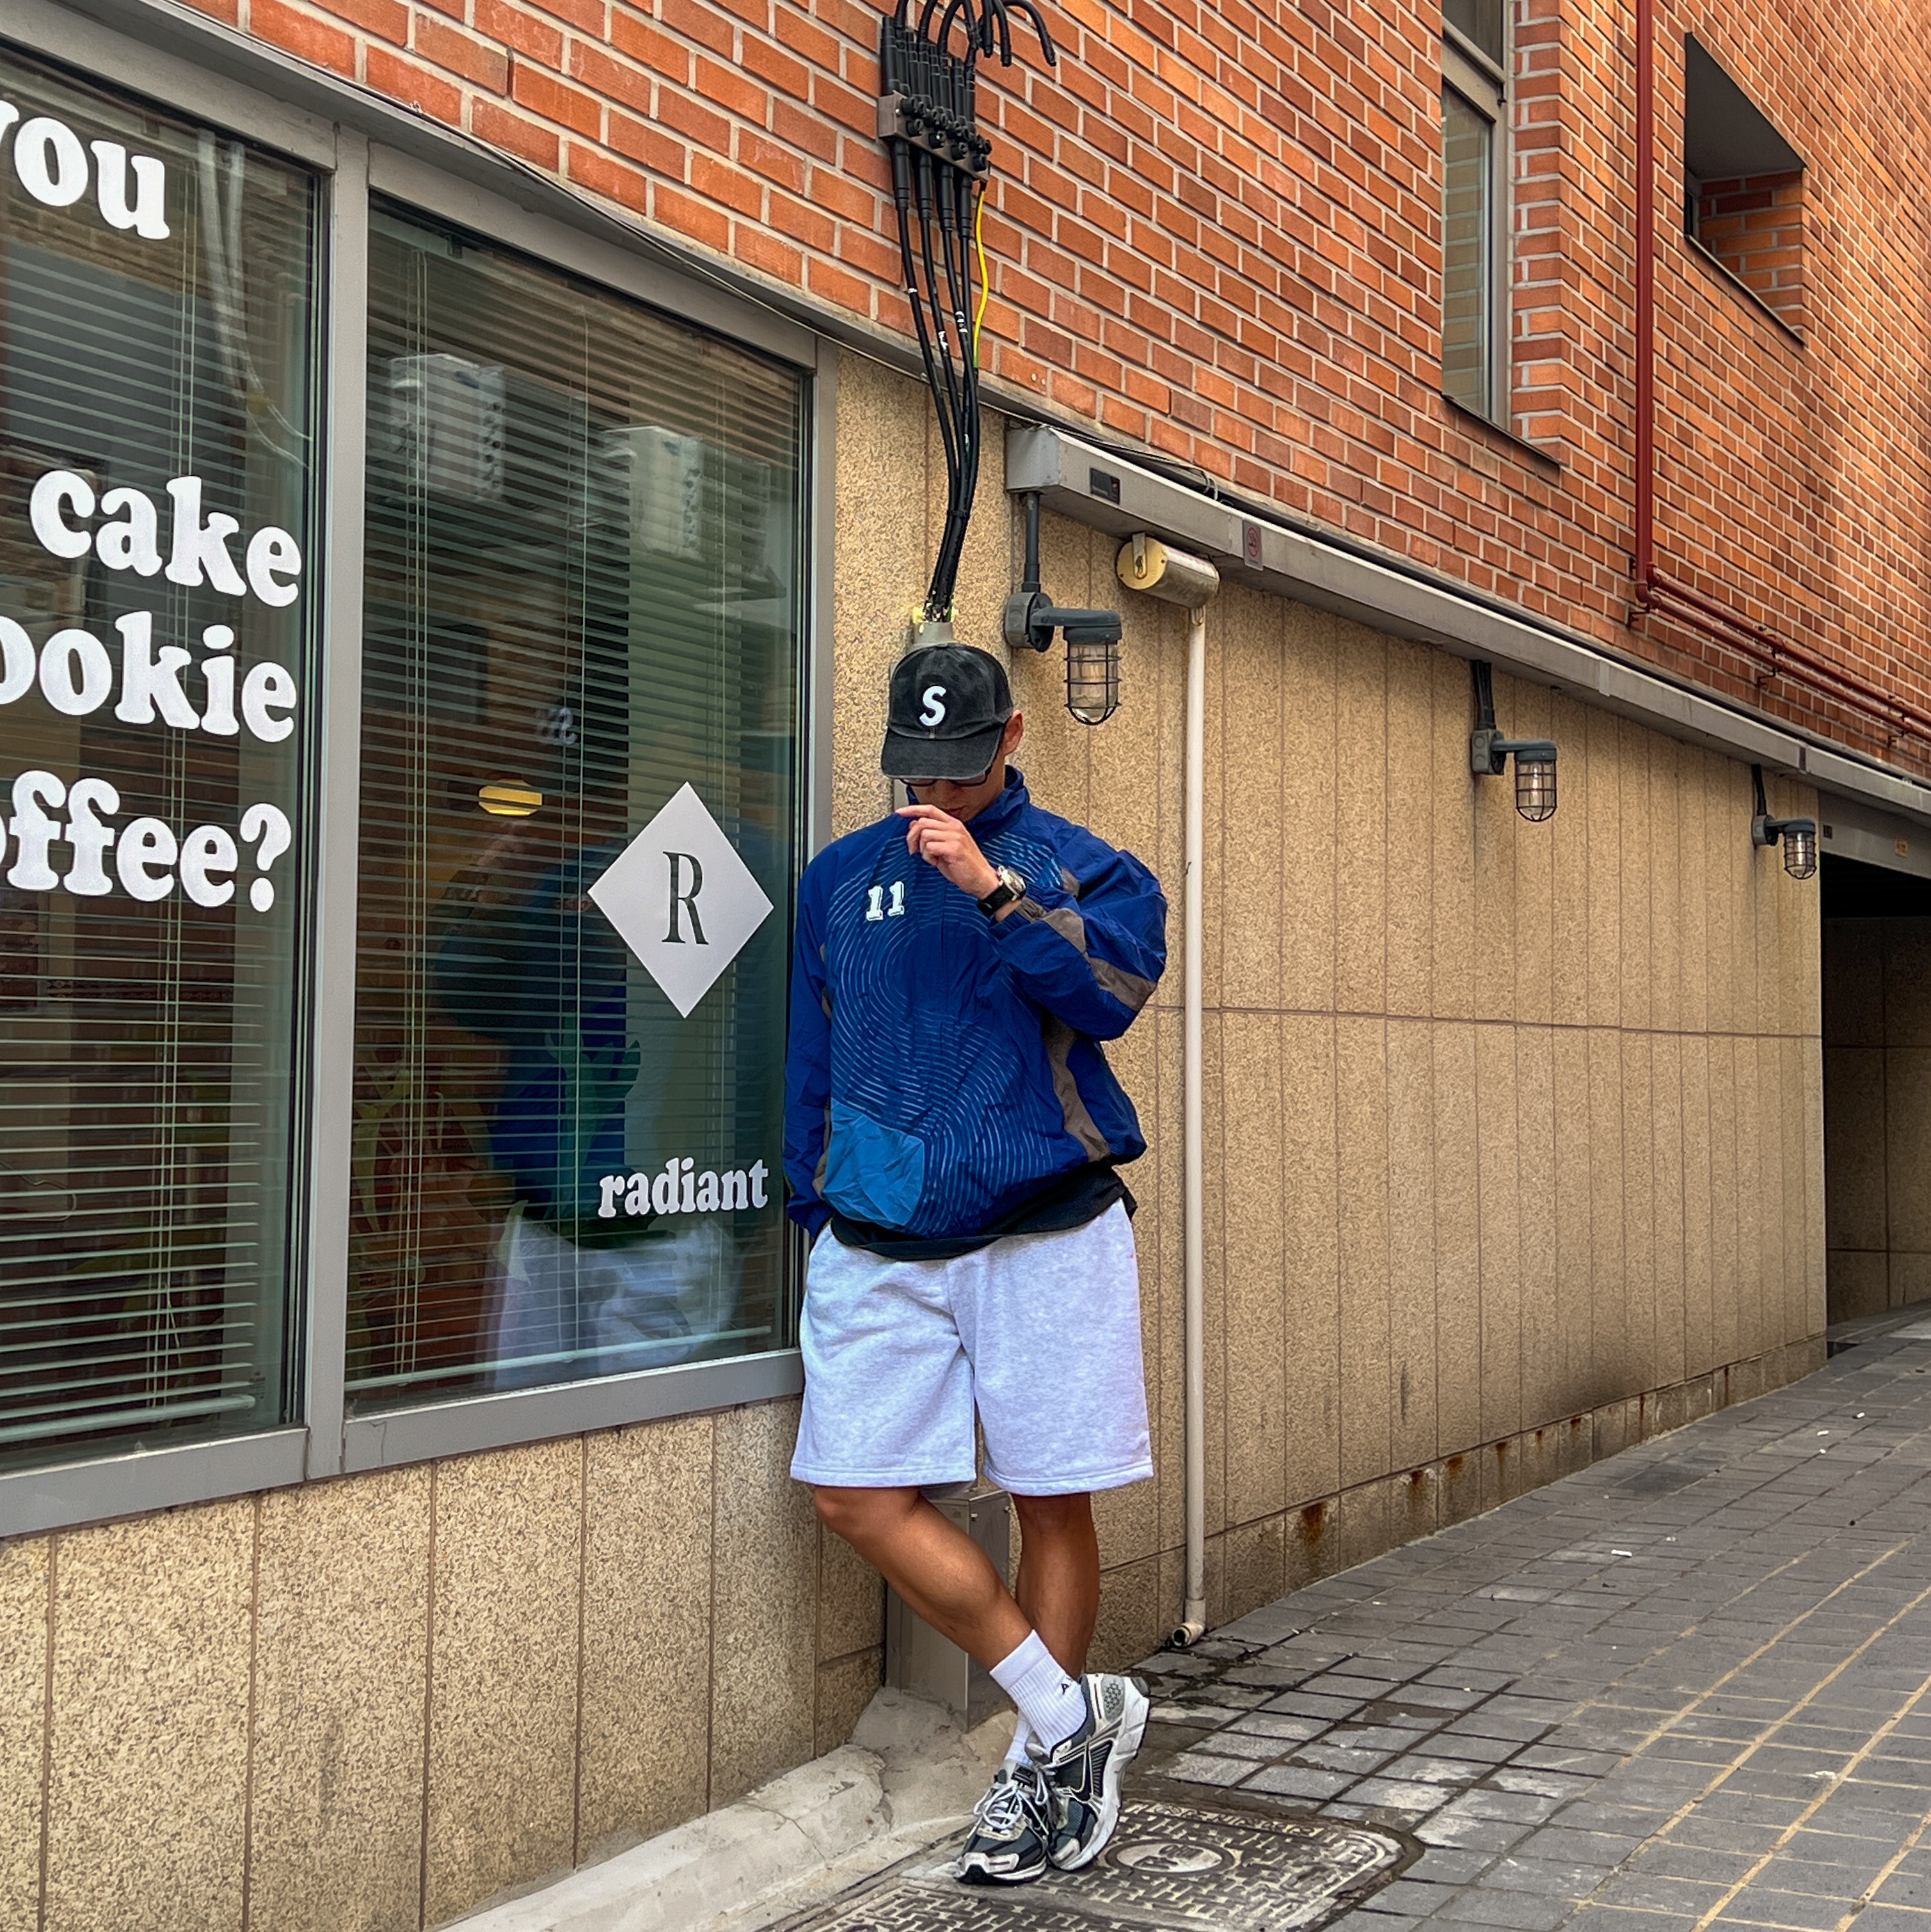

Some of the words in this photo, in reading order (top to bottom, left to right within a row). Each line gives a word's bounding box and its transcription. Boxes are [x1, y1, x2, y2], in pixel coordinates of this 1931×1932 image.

[0, 100, 170, 239] ou
[30, 470, 301, 607] cake
[919, 685, 946, 727] S
[0, 770, 292, 912] ffee?
[662, 851, 709, 946] R
[866, 881, 905, 921] 11
[598, 1157, 768, 1218] radiant
